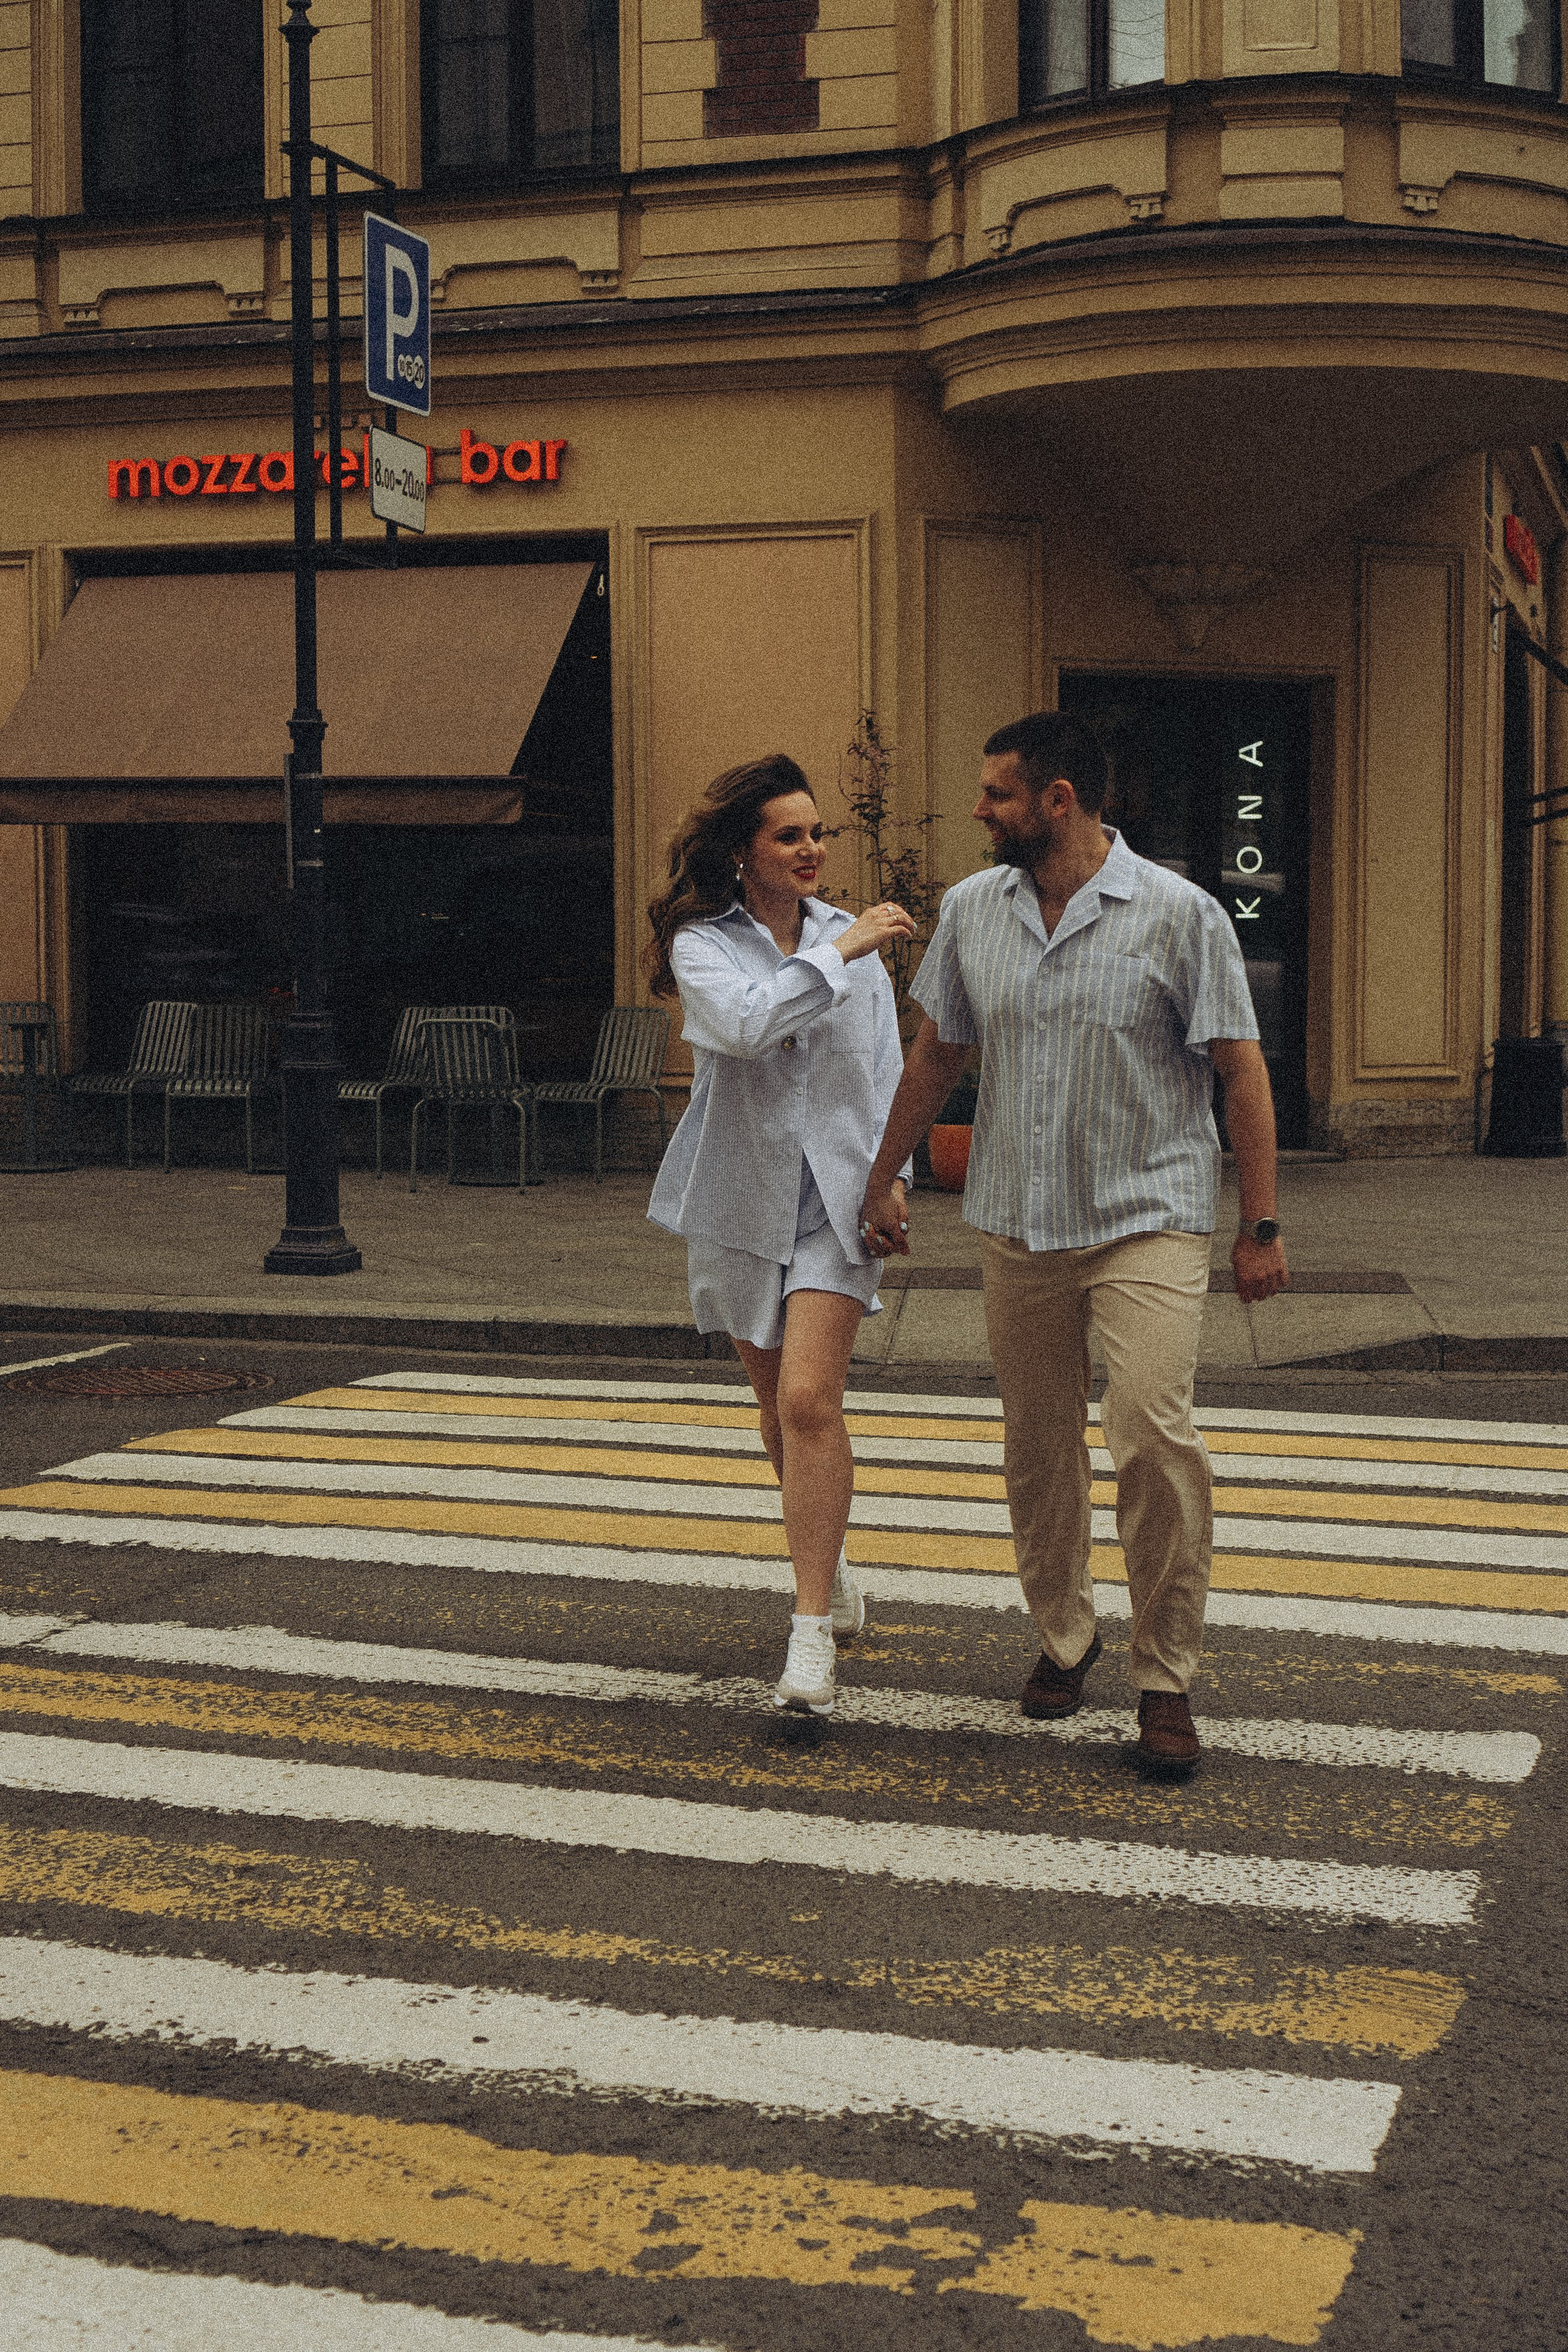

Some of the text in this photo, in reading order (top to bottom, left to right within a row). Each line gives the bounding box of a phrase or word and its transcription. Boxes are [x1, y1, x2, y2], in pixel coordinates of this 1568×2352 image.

[386, 244, 420, 381] P
[107, 429, 567, 499] mozzael bar
[1235, 741, 1264, 918] KONA
